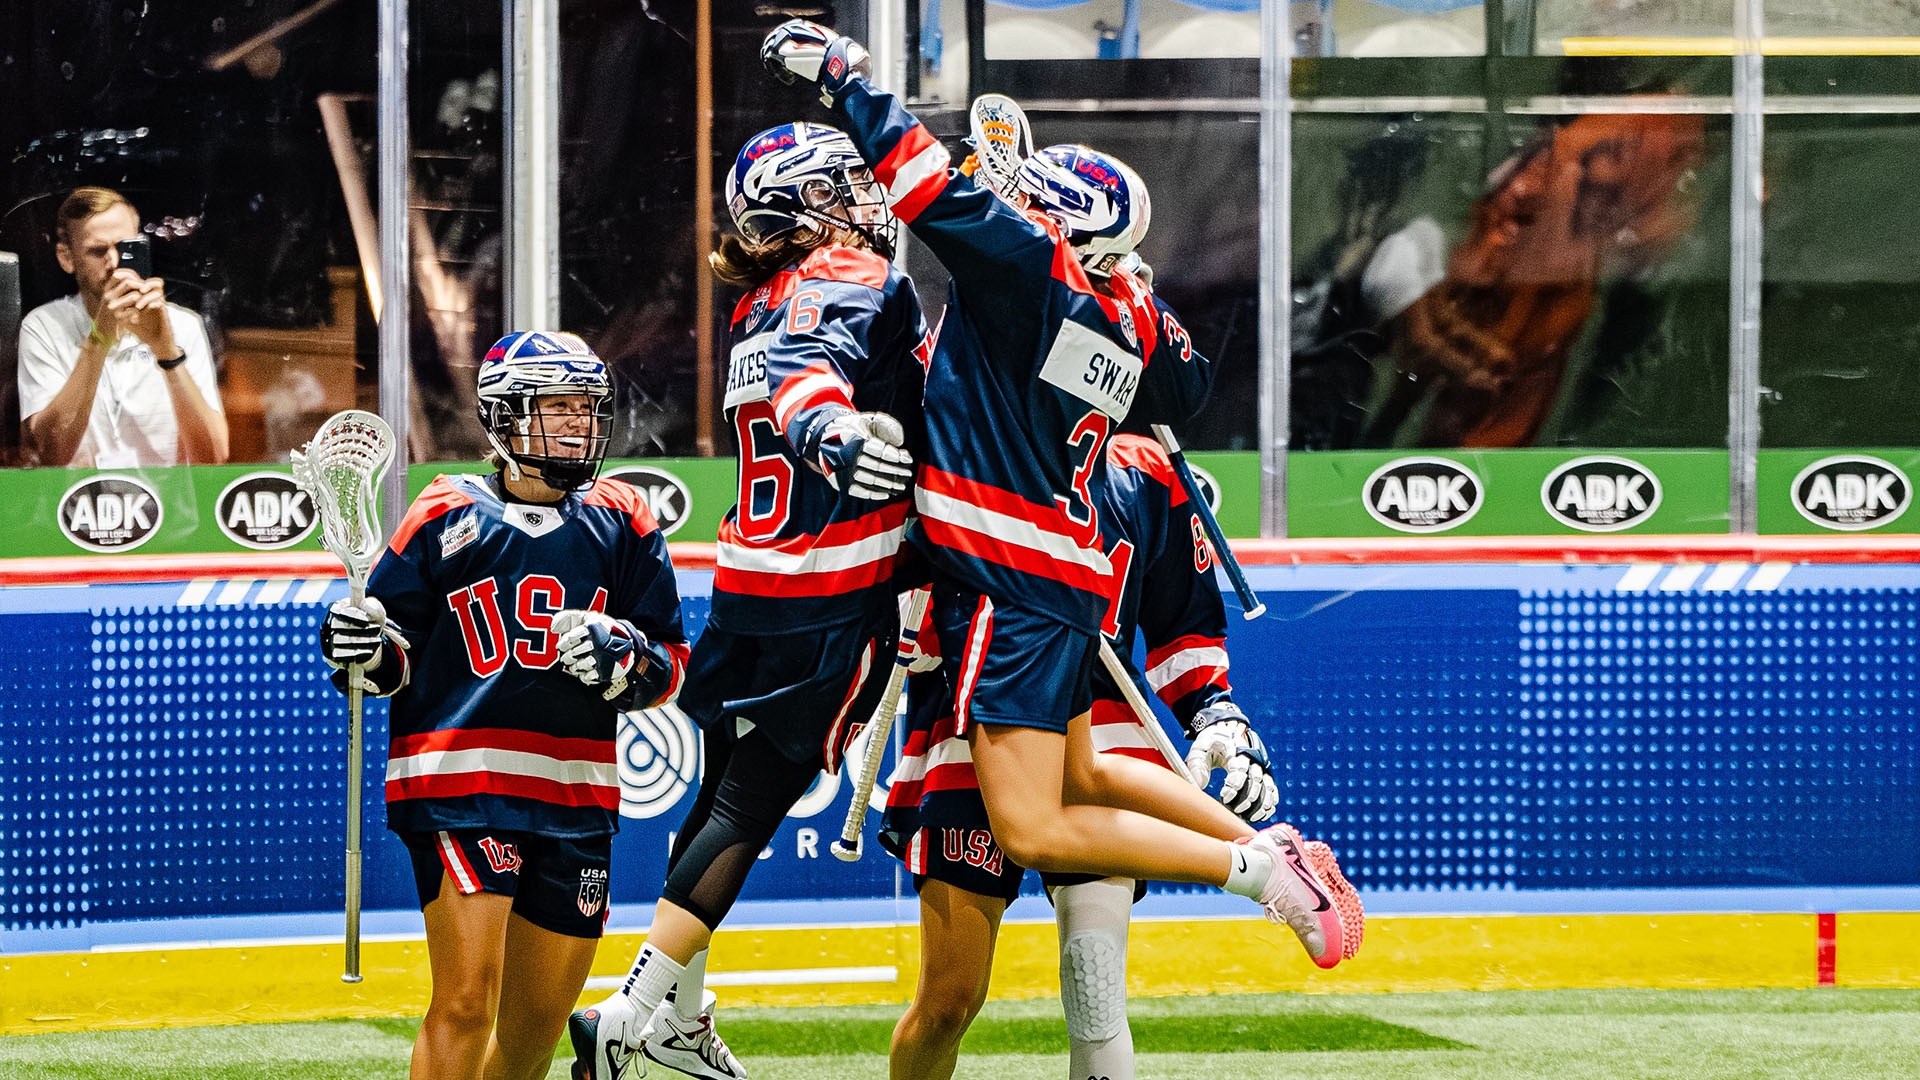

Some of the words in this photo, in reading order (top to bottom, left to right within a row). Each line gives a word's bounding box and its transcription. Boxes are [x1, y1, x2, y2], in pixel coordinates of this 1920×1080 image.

[747, 134, 794, 160] USA
[1077, 160, 1119, 191] USA
[787, 289, 824, 335] 6
[1163, 311, 1192, 363] 3
[728, 350, 767, 392] AKES
[1083, 352, 1136, 409] SWAR
[734, 398, 794, 541] 6
[1053, 408, 1109, 548] 3
[71, 493, 152, 531] ADK
[228, 491, 308, 528] ADK
[1376, 474, 1470, 512] ADK
[1555, 474, 1648, 511] ADK
[1805, 473, 1897, 510] ADK
[1191, 513, 1211, 574] 8
[446, 573, 608, 679] US
[941, 826, 1004, 877] USA
[581, 868, 608, 879] USA
